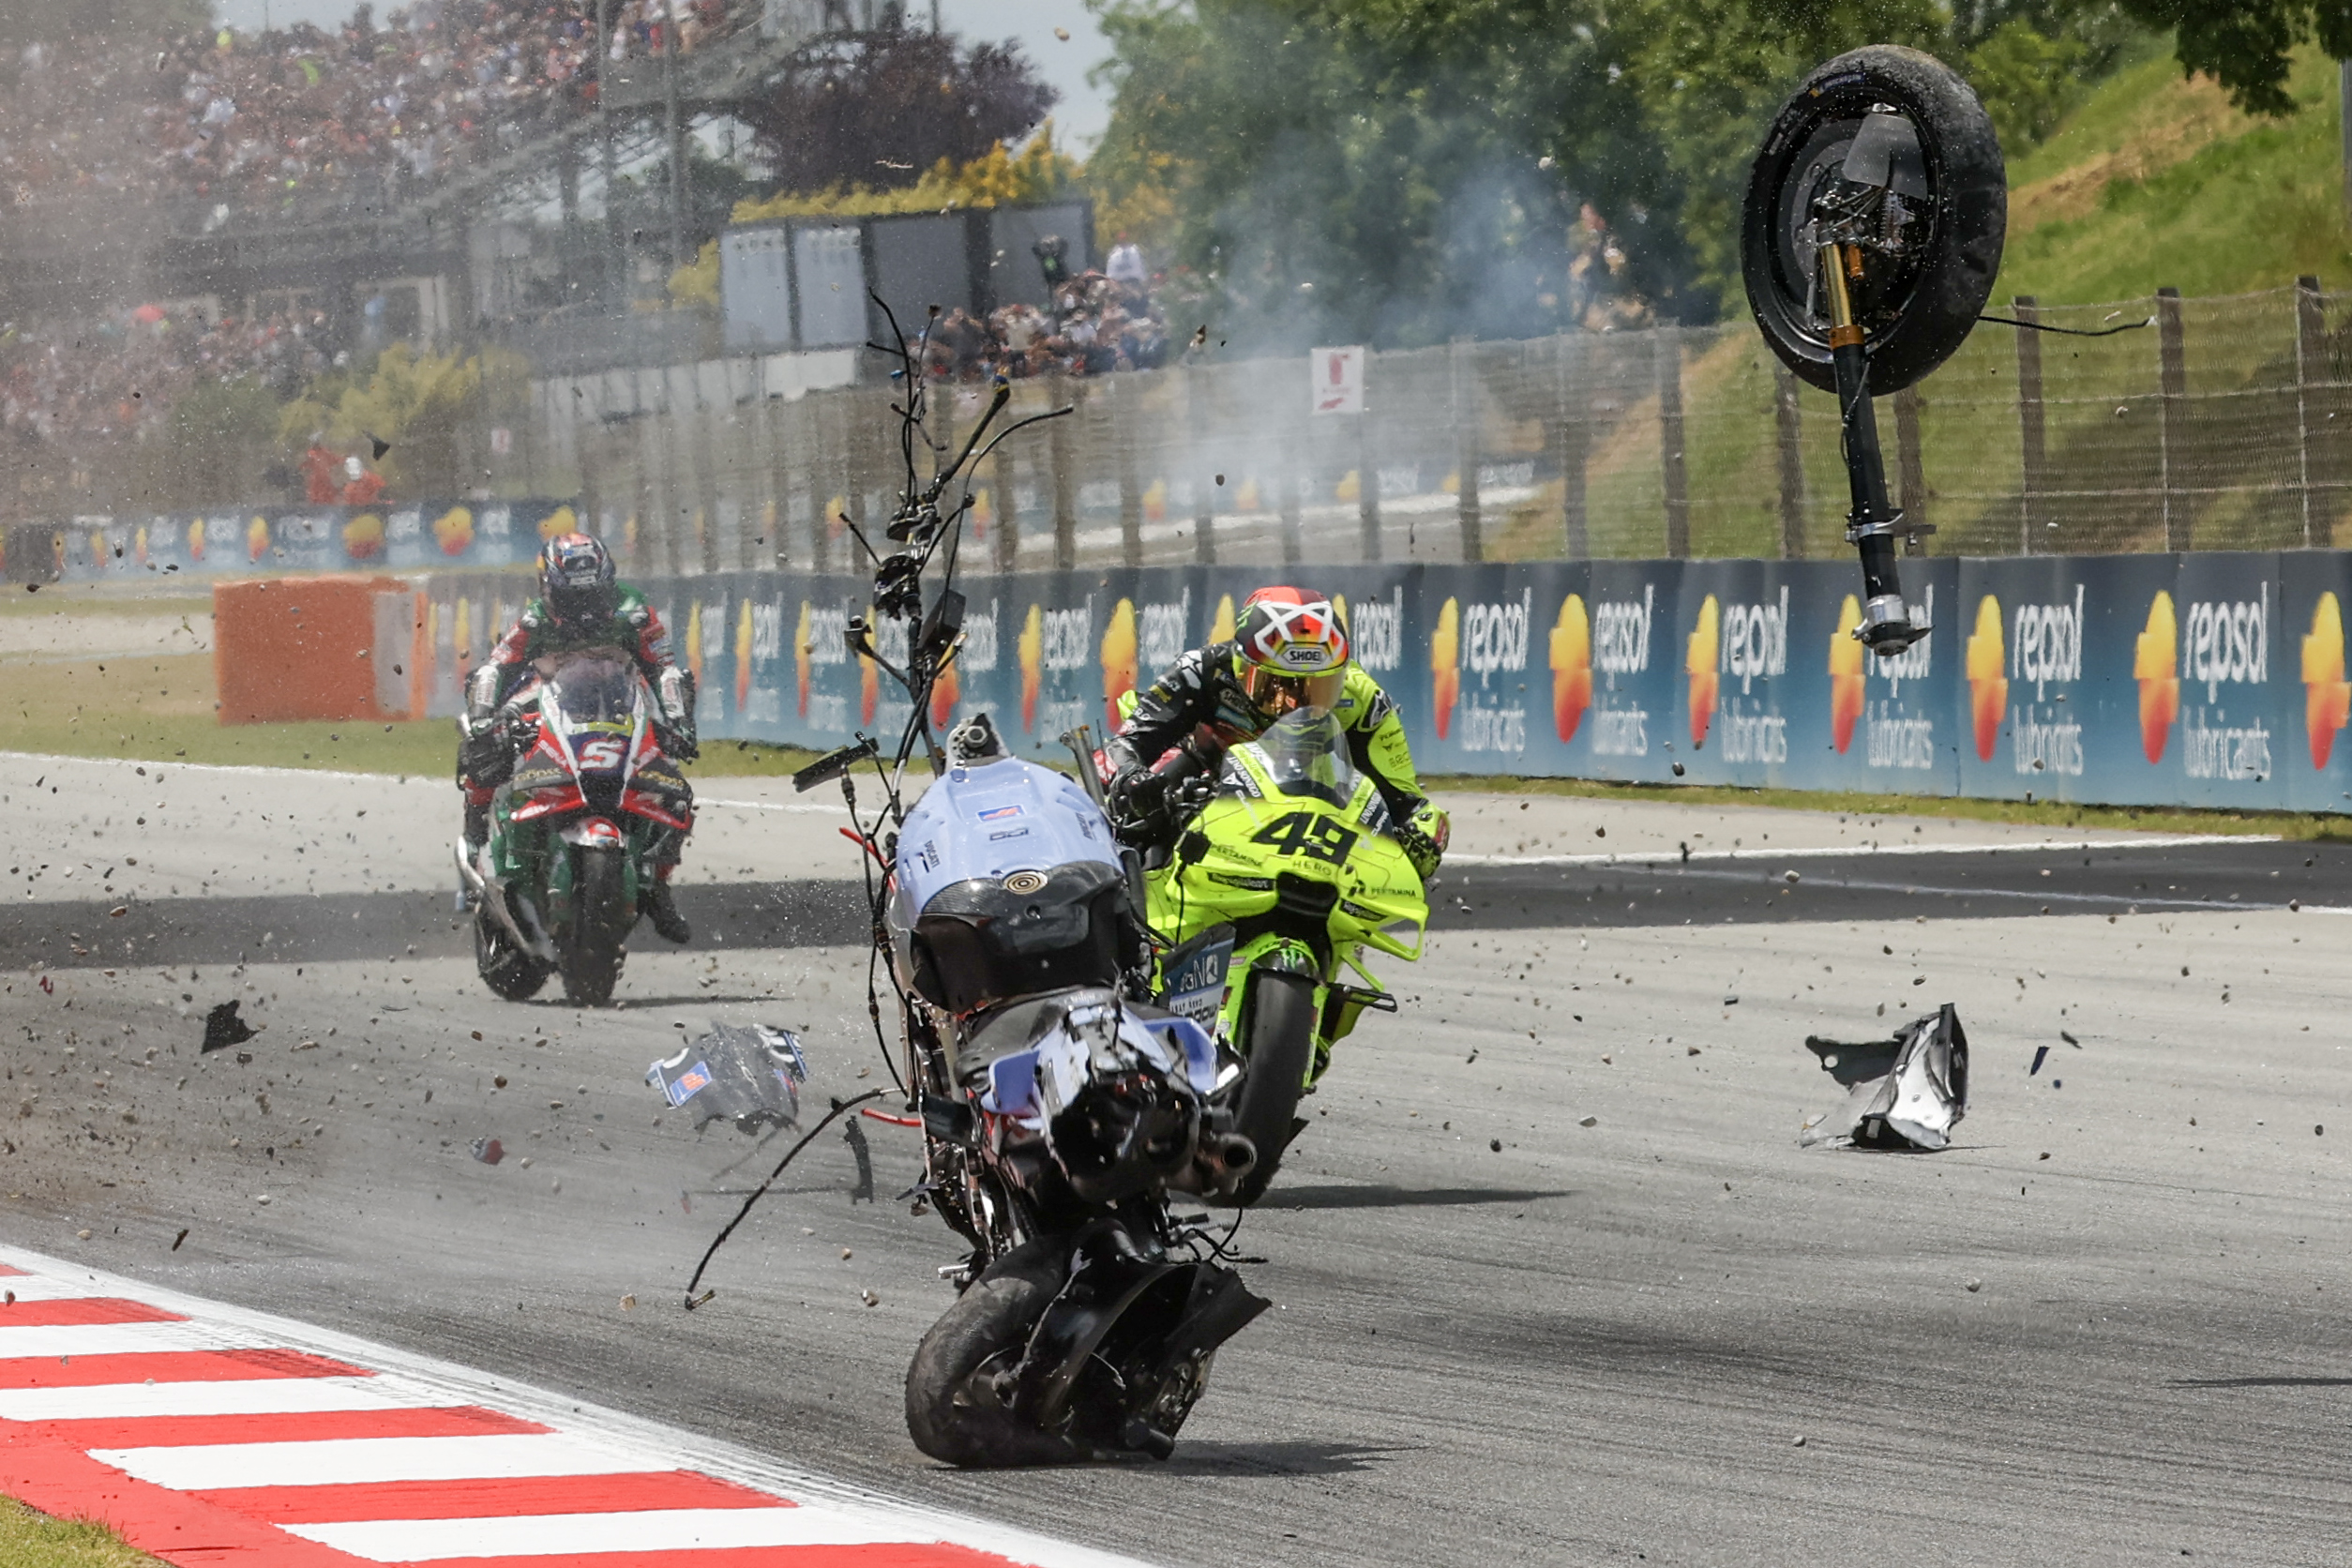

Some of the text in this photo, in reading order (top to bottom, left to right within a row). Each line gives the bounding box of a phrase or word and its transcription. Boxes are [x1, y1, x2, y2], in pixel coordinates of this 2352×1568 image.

[1722, 585, 1789, 695] repsol
[2013, 583, 2085, 702] repsol
[2183, 581, 2269, 704] repsol
[1249, 811, 1360, 869] 49
[1292, 860, 1333, 876] HERO
